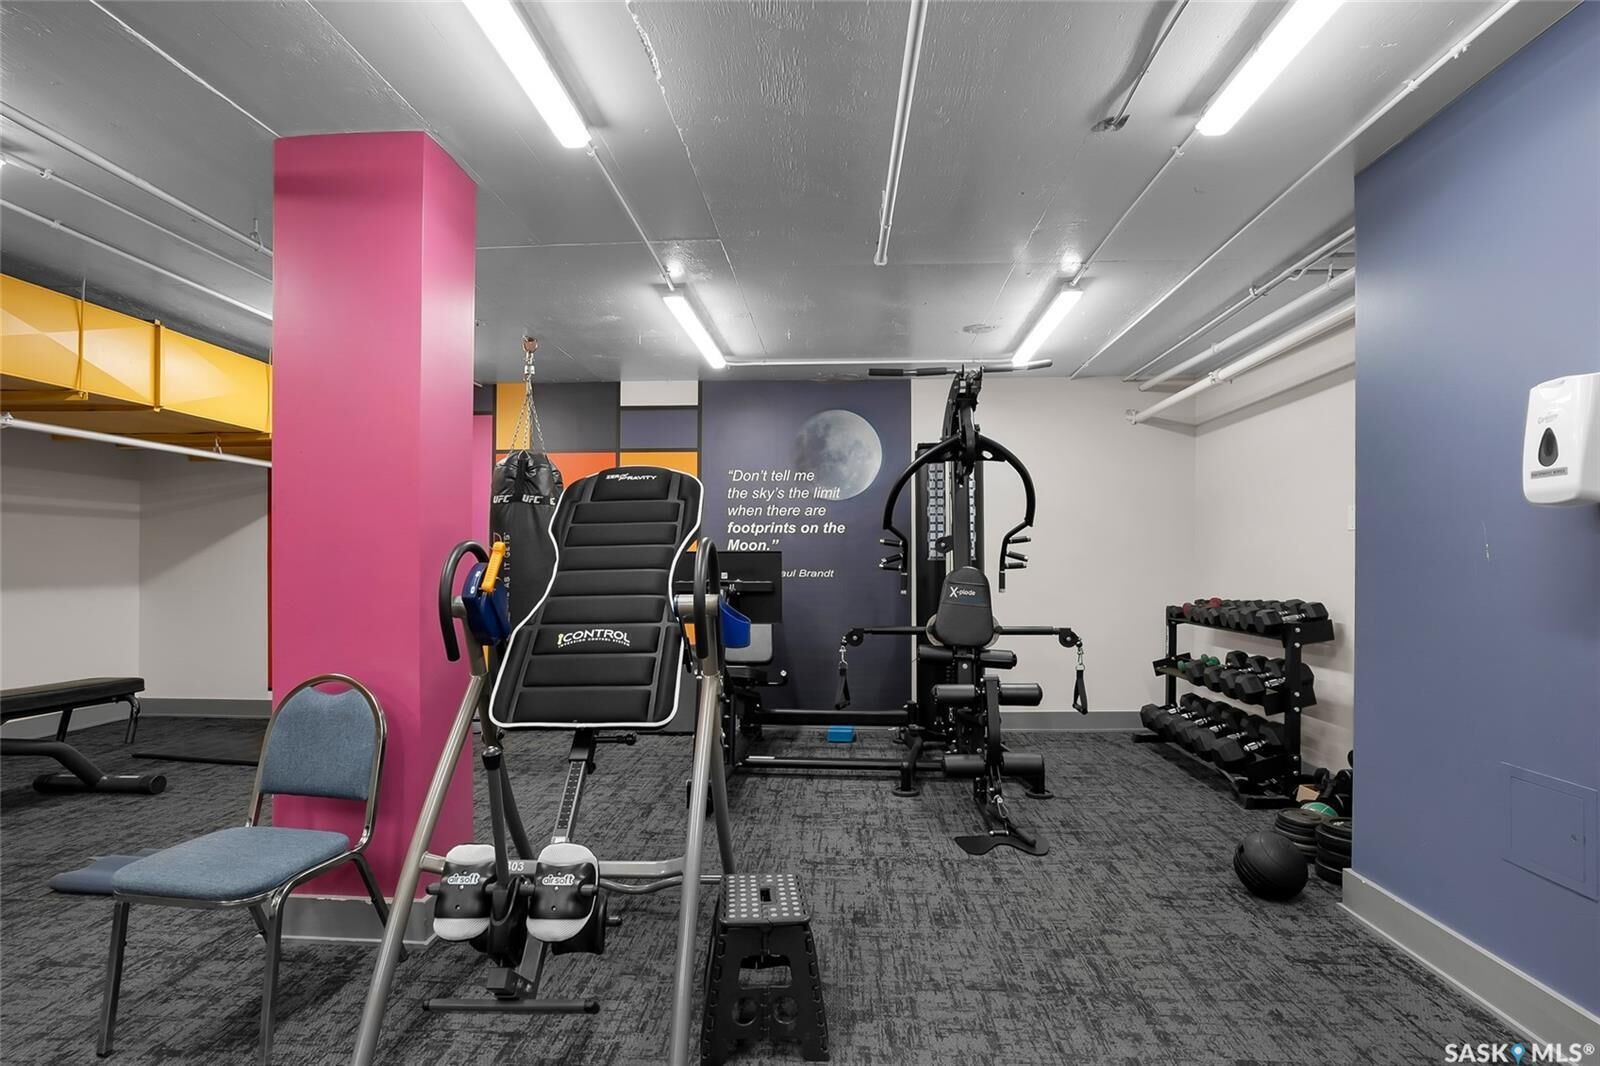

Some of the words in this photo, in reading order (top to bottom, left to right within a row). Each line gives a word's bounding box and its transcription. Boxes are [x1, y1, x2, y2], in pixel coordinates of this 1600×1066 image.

[771, 469, 790, 482] tell
[793, 472, 815, 482] me
[492, 494, 513, 504] UFC
[522, 494, 544, 504] UFC
[727, 487, 748, 499] the
[788, 487, 809, 499] the
[813, 487, 841, 499] limit
[727, 505, 763, 517] when
[766, 505, 801, 517] there
[804, 507, 827, 517] are
[727, 522, 797, 536] footprints
[800, 524, 819, 534] on
[823, 522, 846, 534] the
[781, 569, 796, 578] aul
[798, 569, 835, 578] Brandt
[448, 873, 480, 885] airsoft
[542, 874, 575, 886] airsoft
